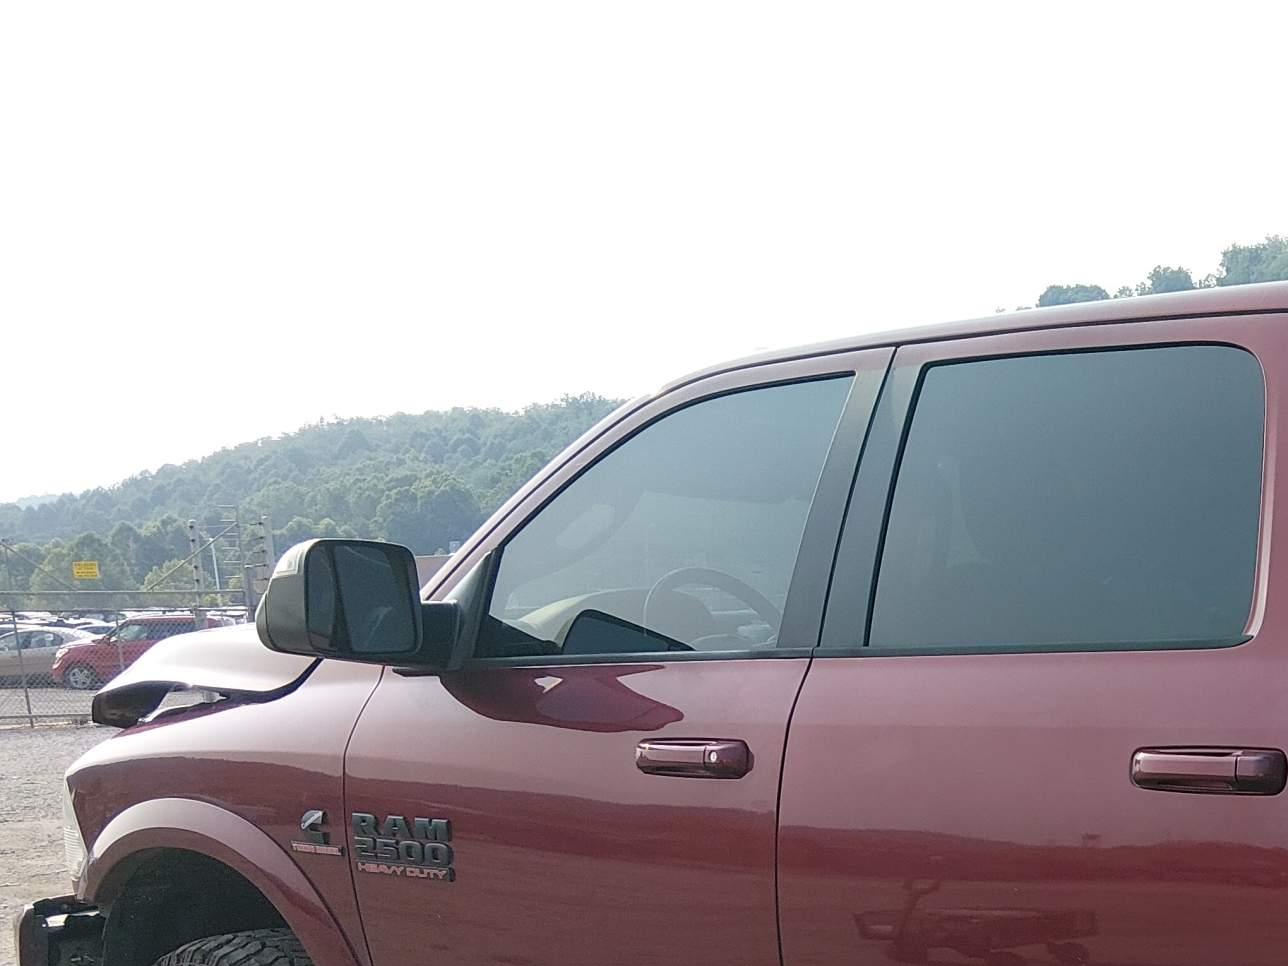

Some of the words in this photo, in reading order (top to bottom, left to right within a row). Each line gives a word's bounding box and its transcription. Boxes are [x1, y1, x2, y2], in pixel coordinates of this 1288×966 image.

[351, 812, 451, 842] RAM
[354, 836, 454, 866] 2500
[357, 862, 405, 876] HEAVY
[406, 866, 448, 880] DUTY
